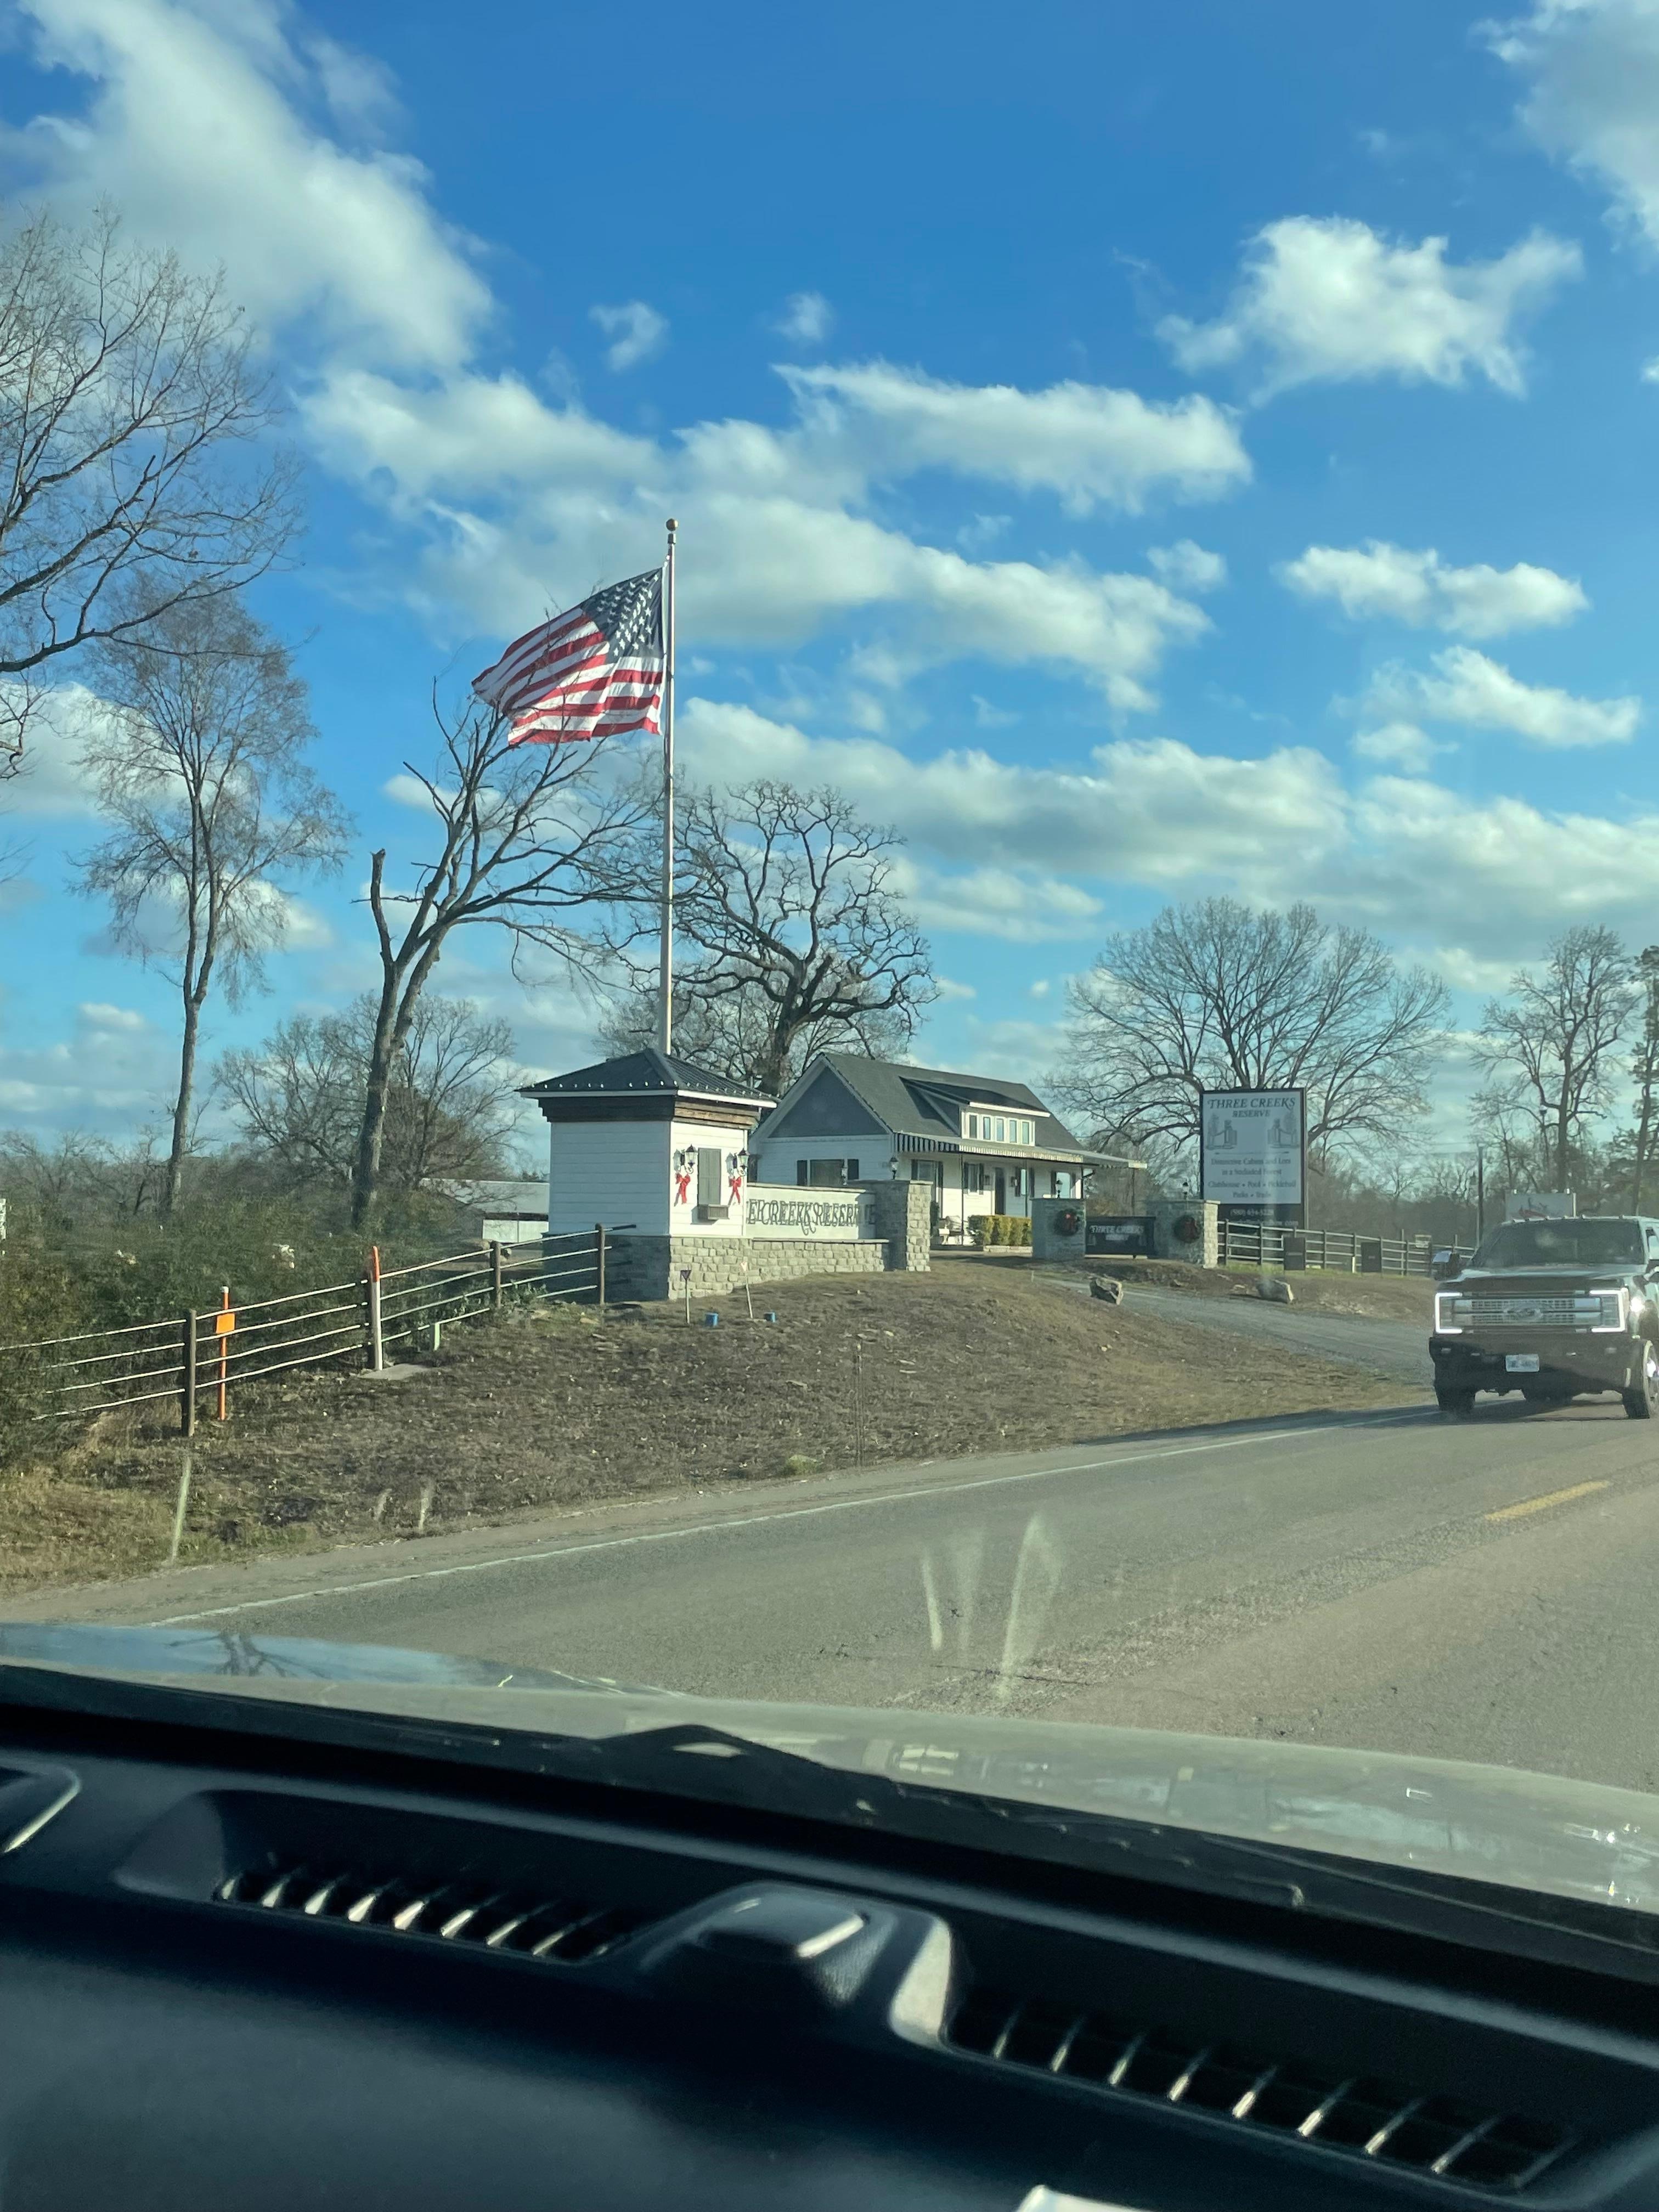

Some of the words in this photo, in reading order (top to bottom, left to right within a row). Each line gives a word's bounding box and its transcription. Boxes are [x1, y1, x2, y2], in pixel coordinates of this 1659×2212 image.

[1207, 1098, 1248, 1109] THREE
[1250, 1097, 1296, 1111] CREEKS
[1232, 1109, 1271, 1118] RESERVE
